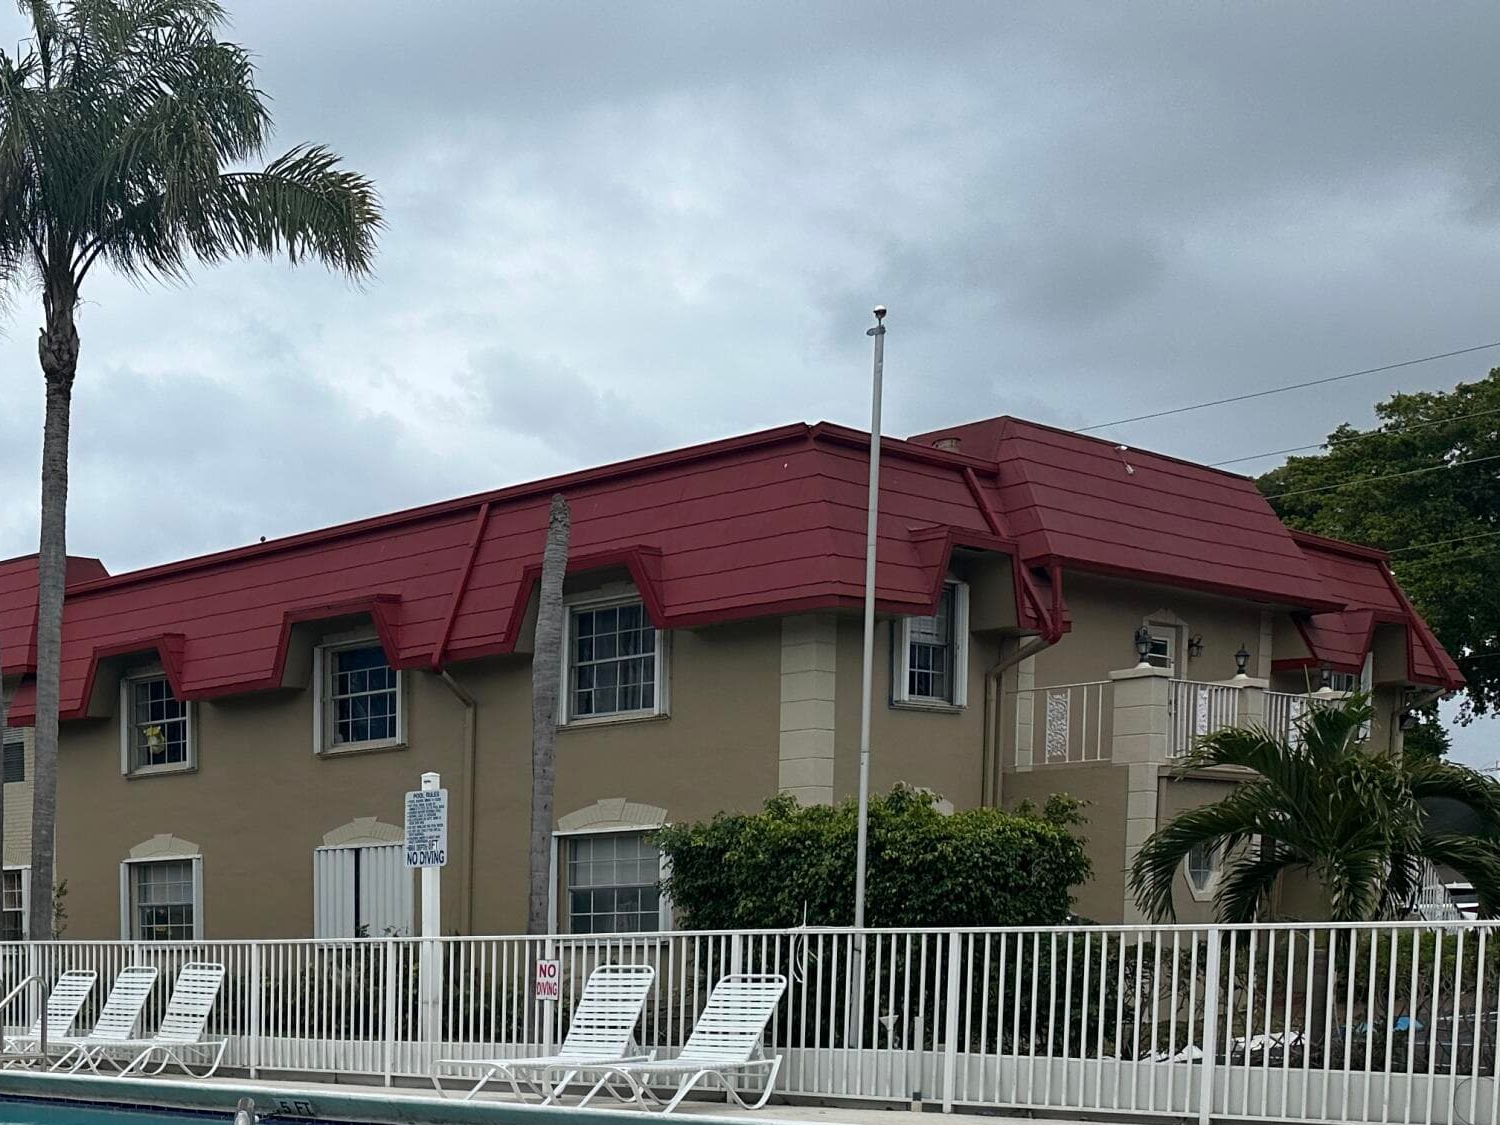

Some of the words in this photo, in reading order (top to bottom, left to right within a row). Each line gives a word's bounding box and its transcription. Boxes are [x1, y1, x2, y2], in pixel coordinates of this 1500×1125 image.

[407, 851, 418, 865] NO
[420, 850, 445, 865] DIVING
[539, 964, 556, 978] NO
[536, 981, 558, 996] DIVING
[280, 1101, 291, 1114] 5
